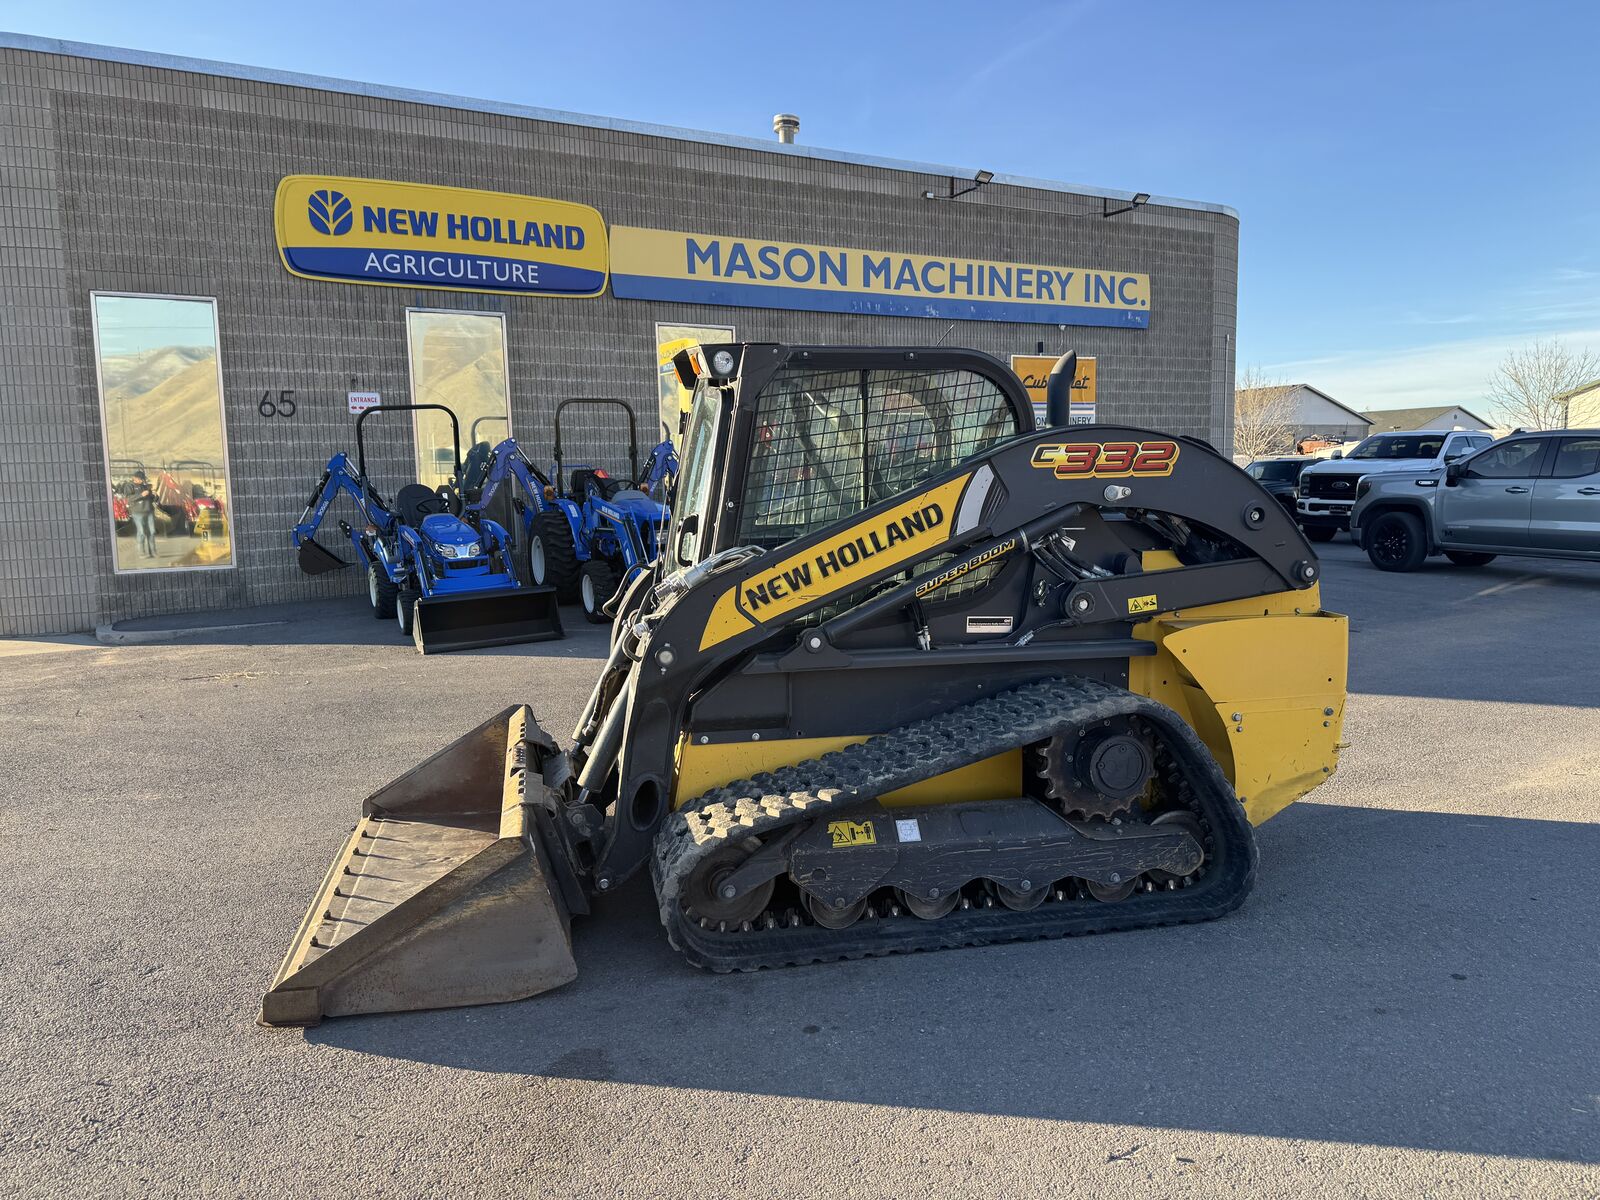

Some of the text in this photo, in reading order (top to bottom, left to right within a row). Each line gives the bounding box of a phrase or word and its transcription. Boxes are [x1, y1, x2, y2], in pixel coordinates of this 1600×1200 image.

[363, 206, 586, 250] NEW HOLLAND
[364, 252, 539, 284] AGRICULTURE
[686, 238, 1147, 307] MASON MACHINERY INC.
[1022, 374, 1048, 389] Cub
[259, 390, 296, 418] 65
[1070, 416, 1092, 425] INERY
[1031, 442, 1180, 479] C332
[745, 503, 944, 611] NEW HOLLAND
[915, 539, 1015, 597] SUPER BOOM
